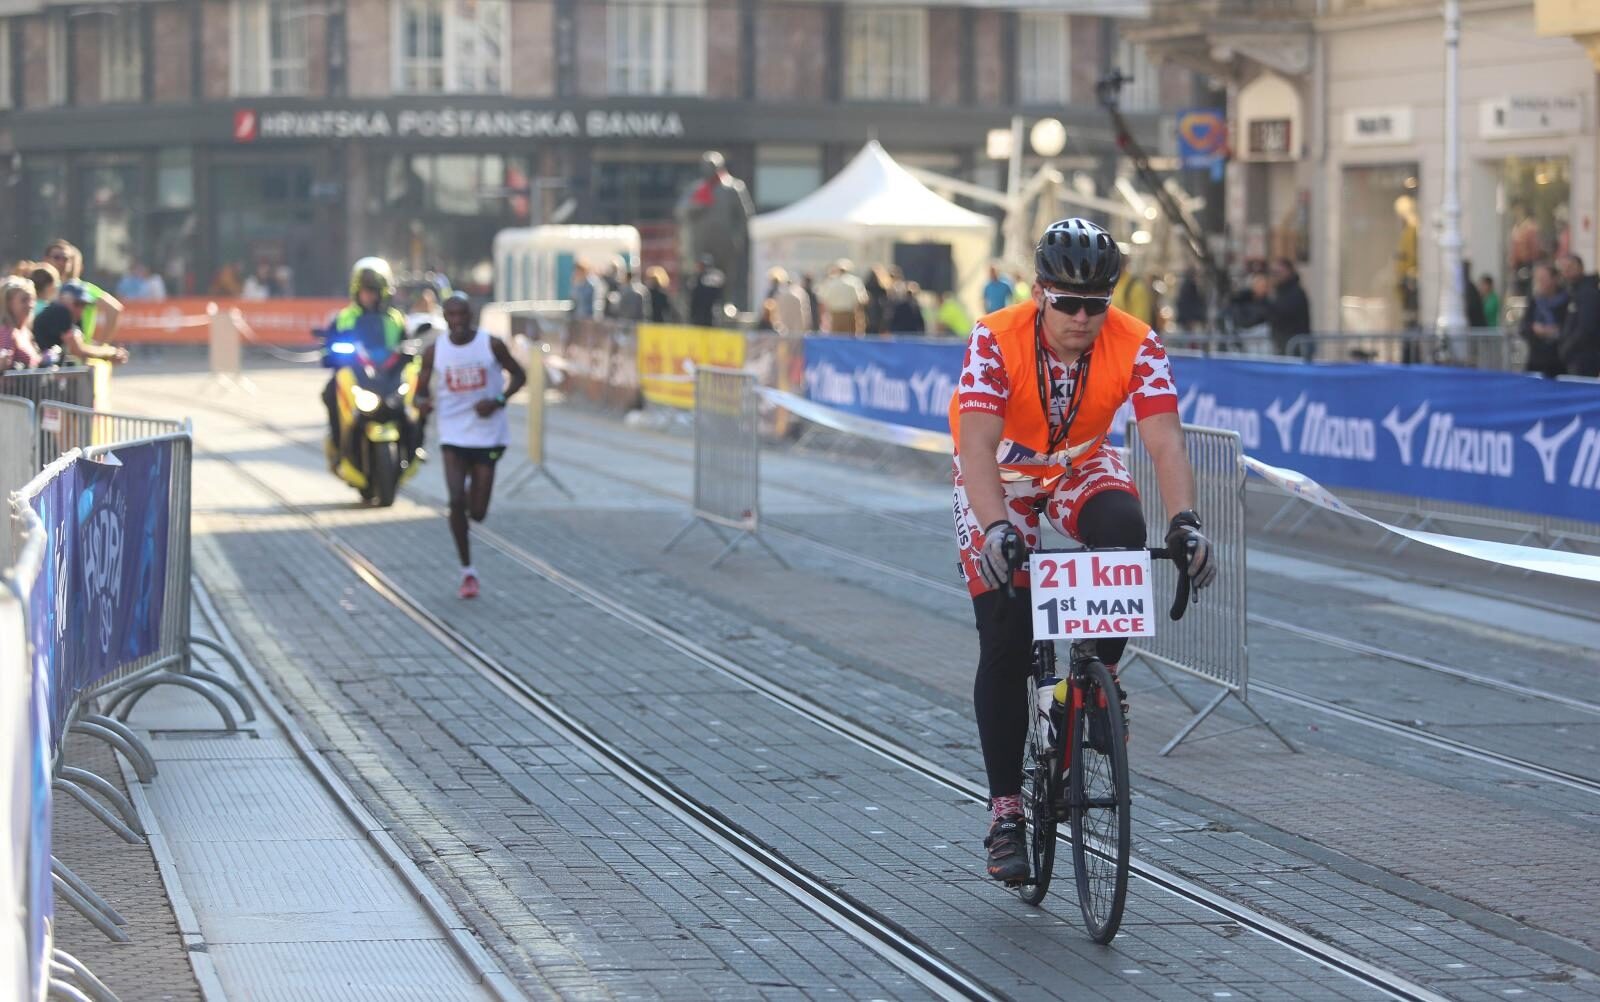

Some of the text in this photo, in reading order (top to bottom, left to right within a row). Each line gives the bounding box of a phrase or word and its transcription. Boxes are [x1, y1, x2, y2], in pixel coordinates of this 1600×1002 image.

[260, 106, 684, 137] HRVATSKA POŠTANSKA BANKA
[1038, 556, 1143, 588] 21 km
[1037, 596, 1144, 635] 1st MAN
[1065, 617, 1145, 634] PLACE
